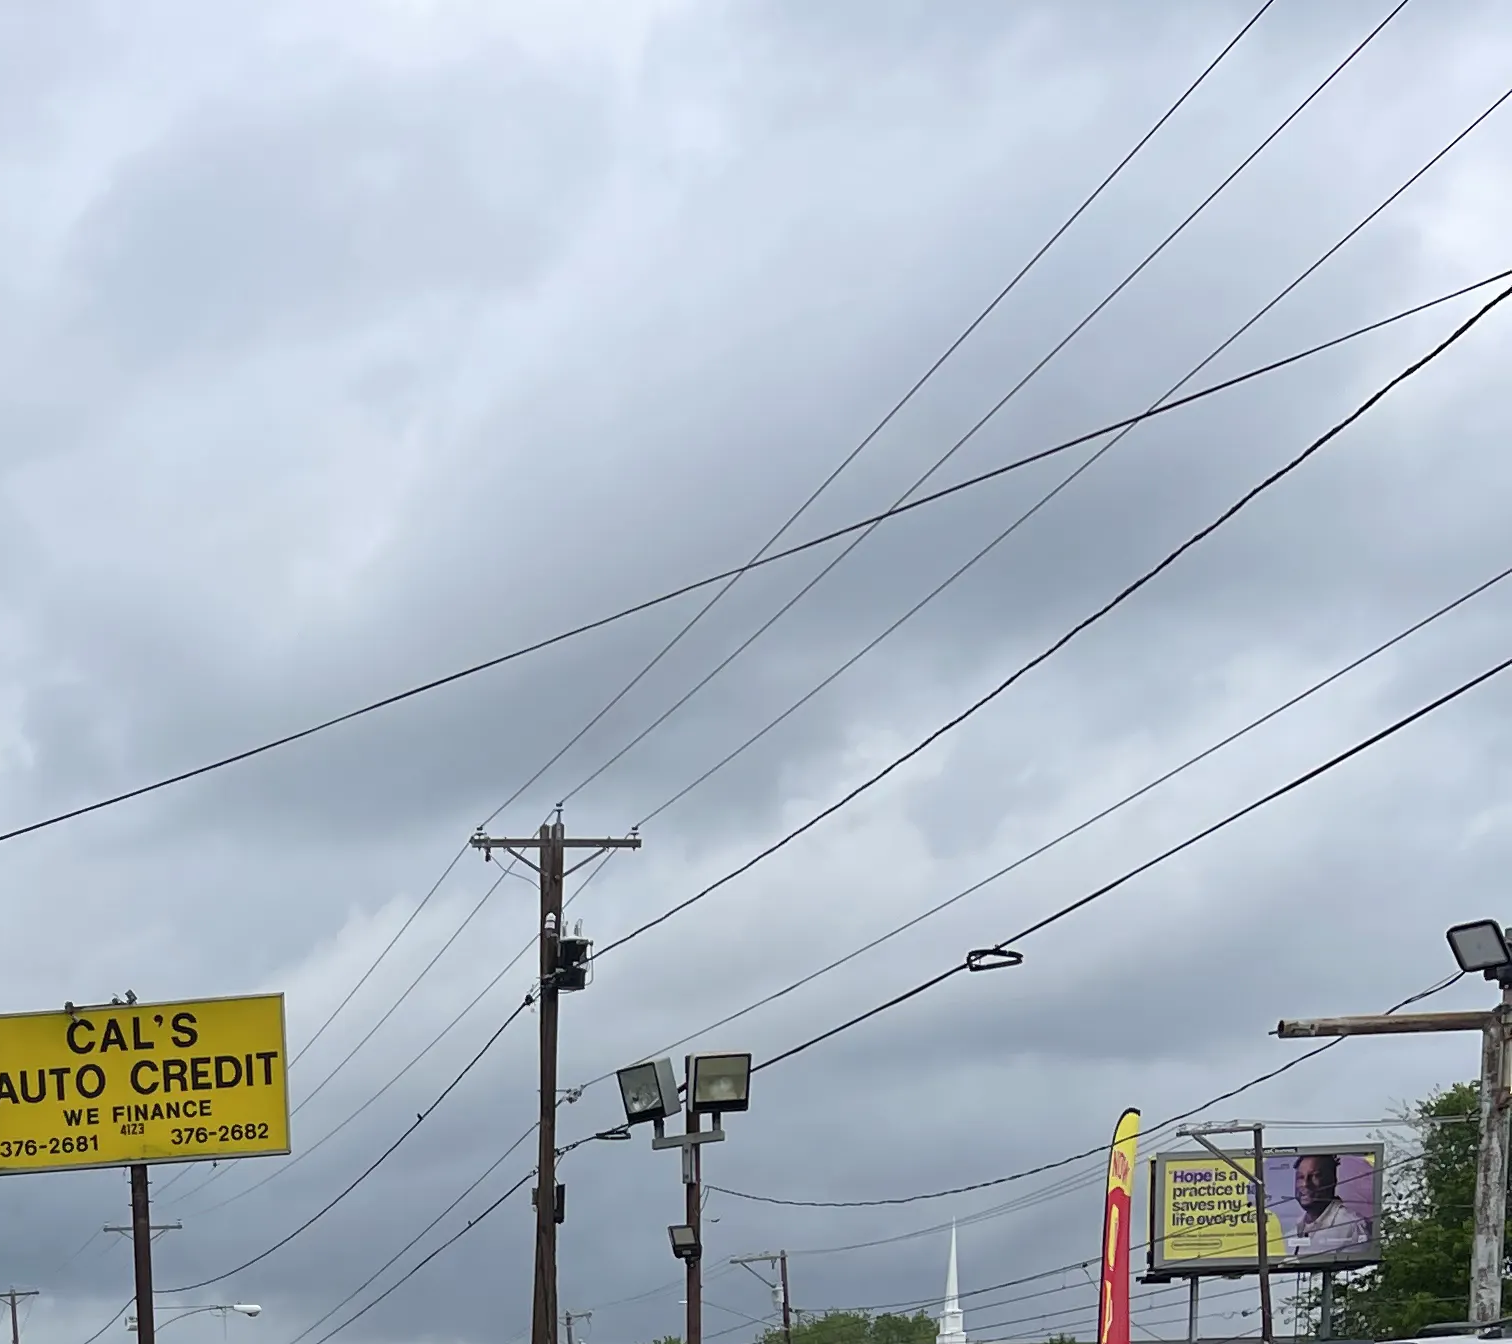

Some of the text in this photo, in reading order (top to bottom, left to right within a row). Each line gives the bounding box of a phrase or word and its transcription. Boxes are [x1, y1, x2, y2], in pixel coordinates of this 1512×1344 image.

[66, 1012, 198, 1055] CAL'S
[130, 1051, 278, 1096] CREDIT
[63, 1100, 212, 1127] WE FINANCE
[120, 1123, 145, 1136] 4123
[171, 1123, 269, 1146] 376-2682
[0, 1135, 99, 1158] 376-2681
[1214, 1167, 1227, 1181] is
[1229, 1170, 1238, 1181] a
[1172, 1182, 1233, 1200] practice
[1172, 1199, 1242, 1212] saves my
[1172, 1212, 1195, 1227] life
[1196, 1213, 1239, 1228] every
